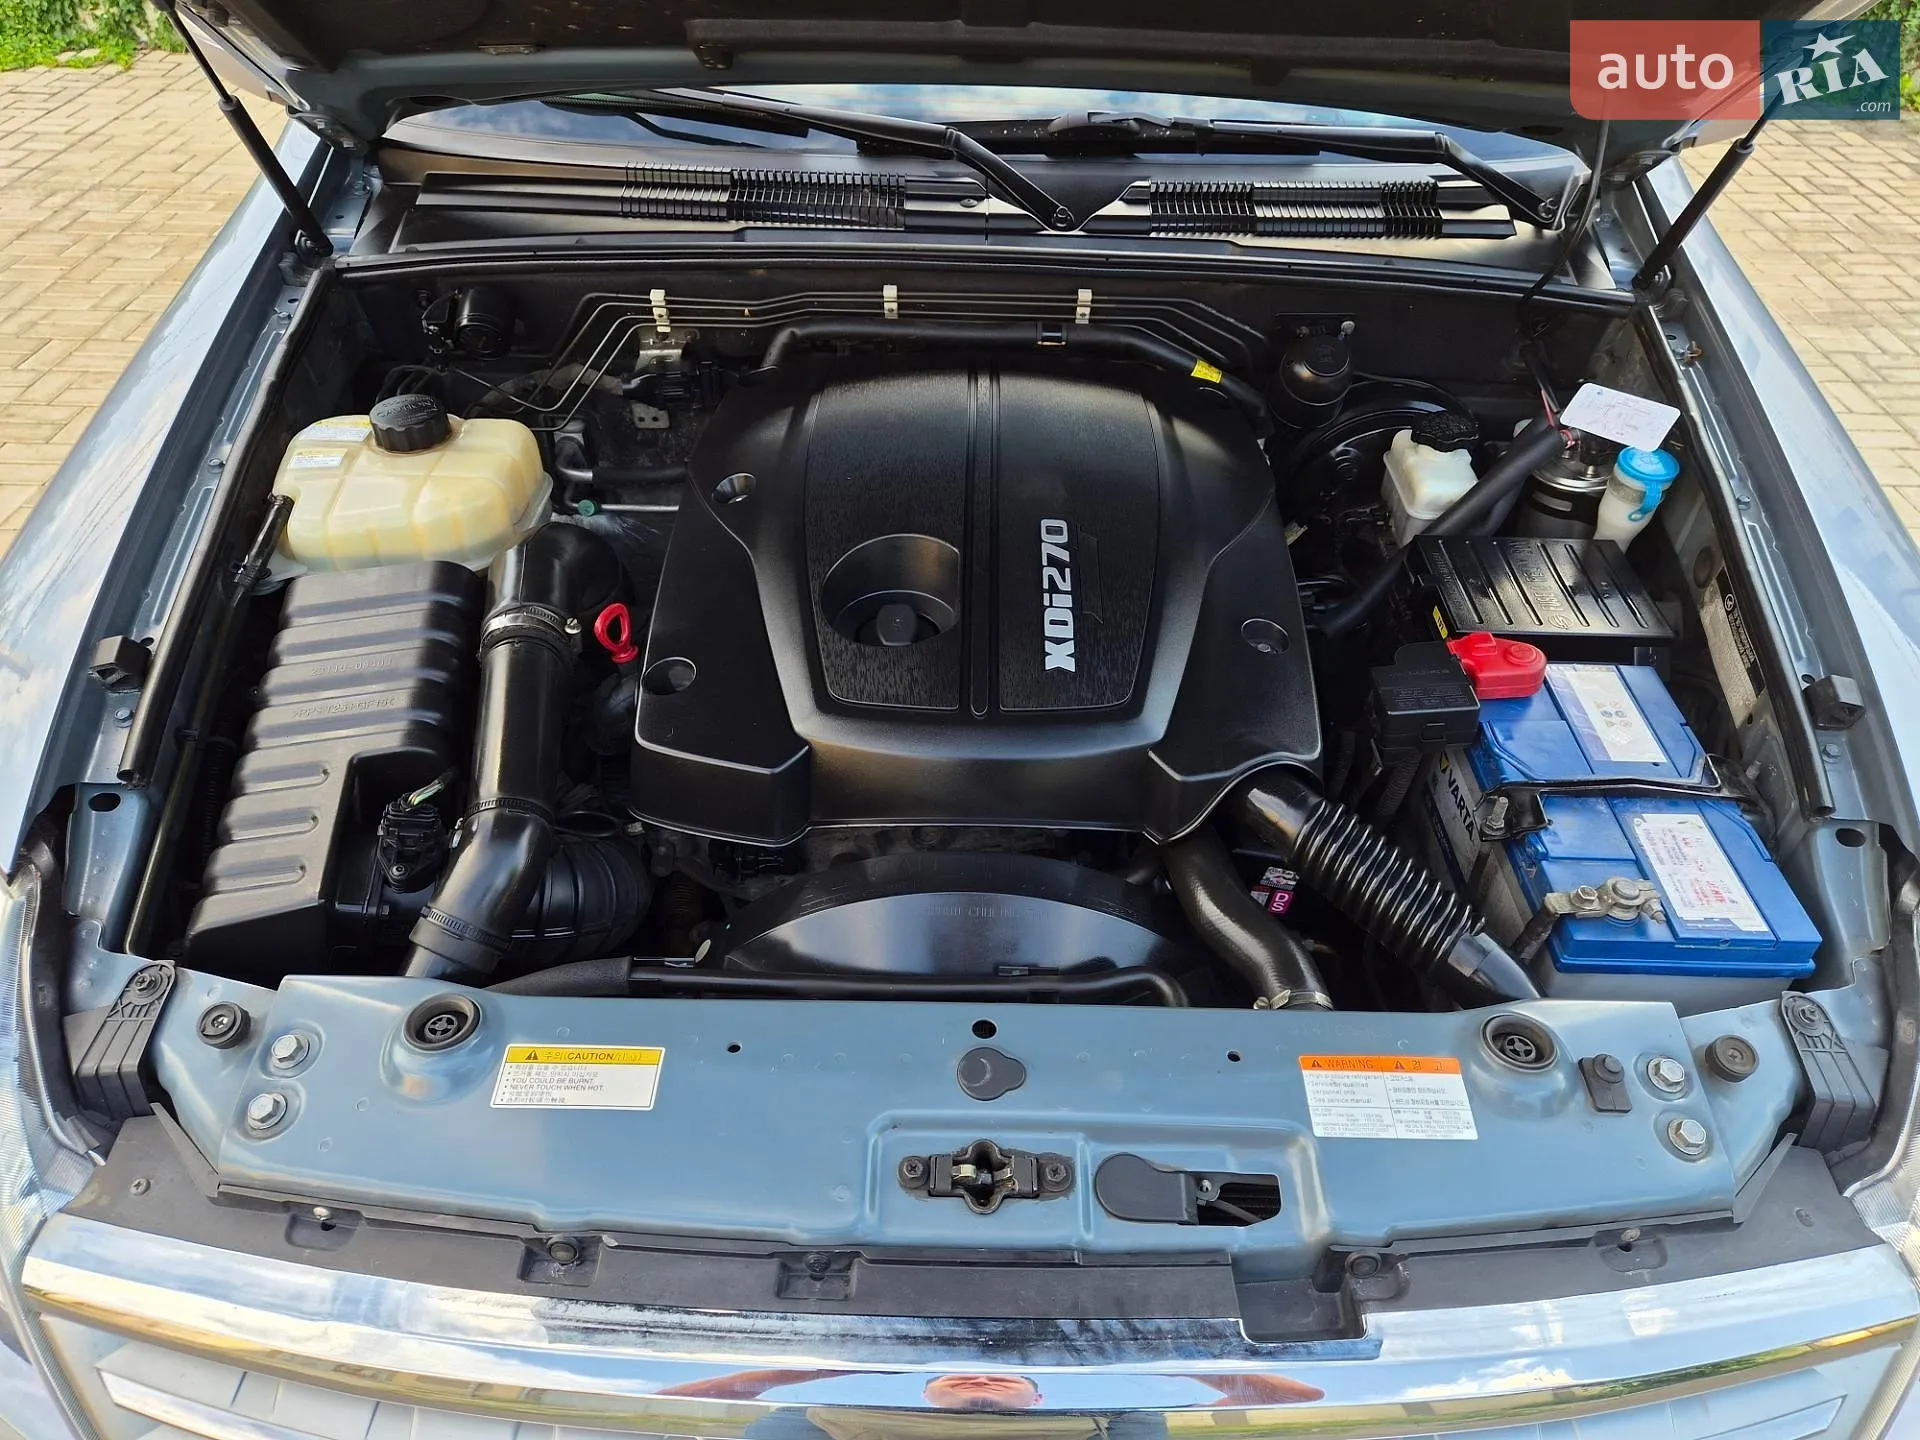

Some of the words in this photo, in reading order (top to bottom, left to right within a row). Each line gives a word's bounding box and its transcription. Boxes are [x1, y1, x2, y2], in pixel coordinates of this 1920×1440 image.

[1040, 518, 1076, 673] XDi270
[1448, 768, 1475, 841] VARTA
[529, 1077, 555, 1085] COULD
[1327, 1059, 1374, 1069] WARNING
